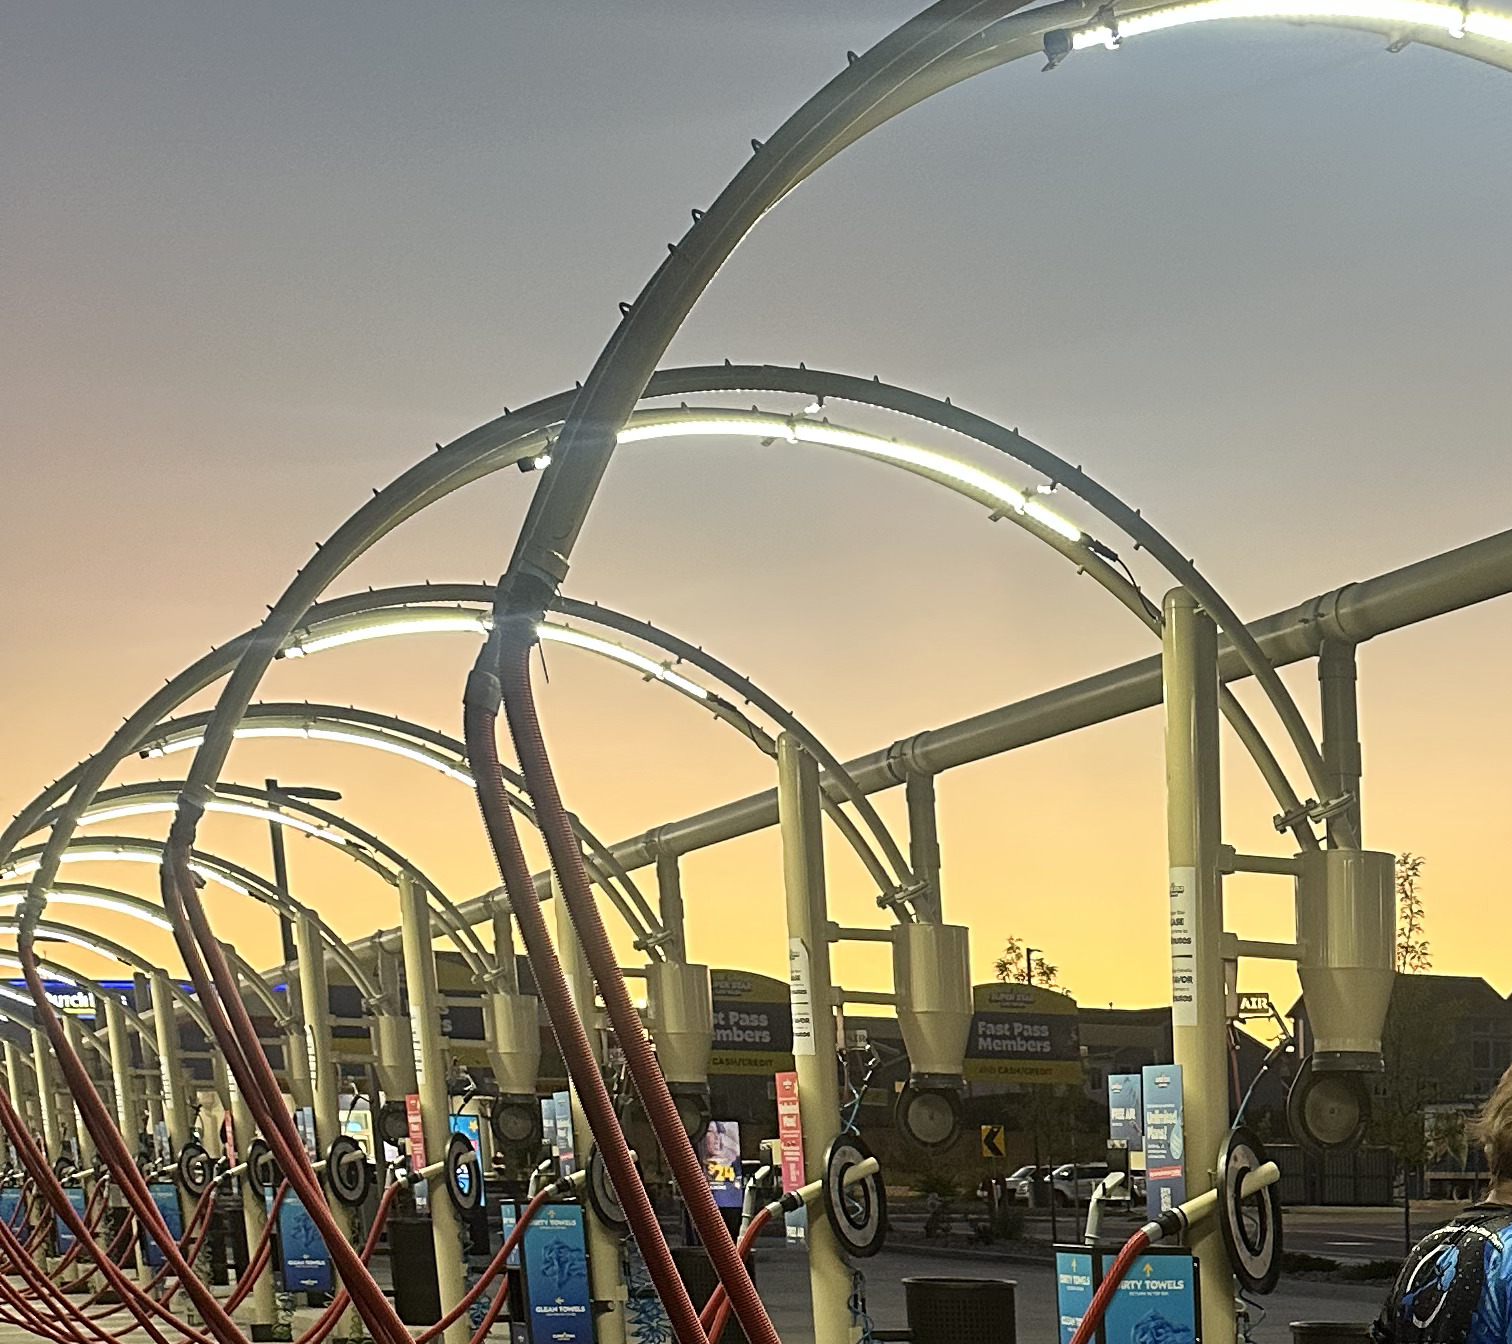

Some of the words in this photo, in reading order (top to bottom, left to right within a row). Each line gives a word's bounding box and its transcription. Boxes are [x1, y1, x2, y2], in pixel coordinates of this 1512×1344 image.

[1240, 997, 1269, 1010] AIR
[728, 1010, 770, 1027] Pass
[977, 1021, 1011, 1036] Fast
[1013, 1022, 1050, 1037] Pass
[977, 1037, 1052, 1053] Members
[1119, 1280, 1143, 1291] IRTY
[1144, 1279, 1185, 1291] TOWELS
